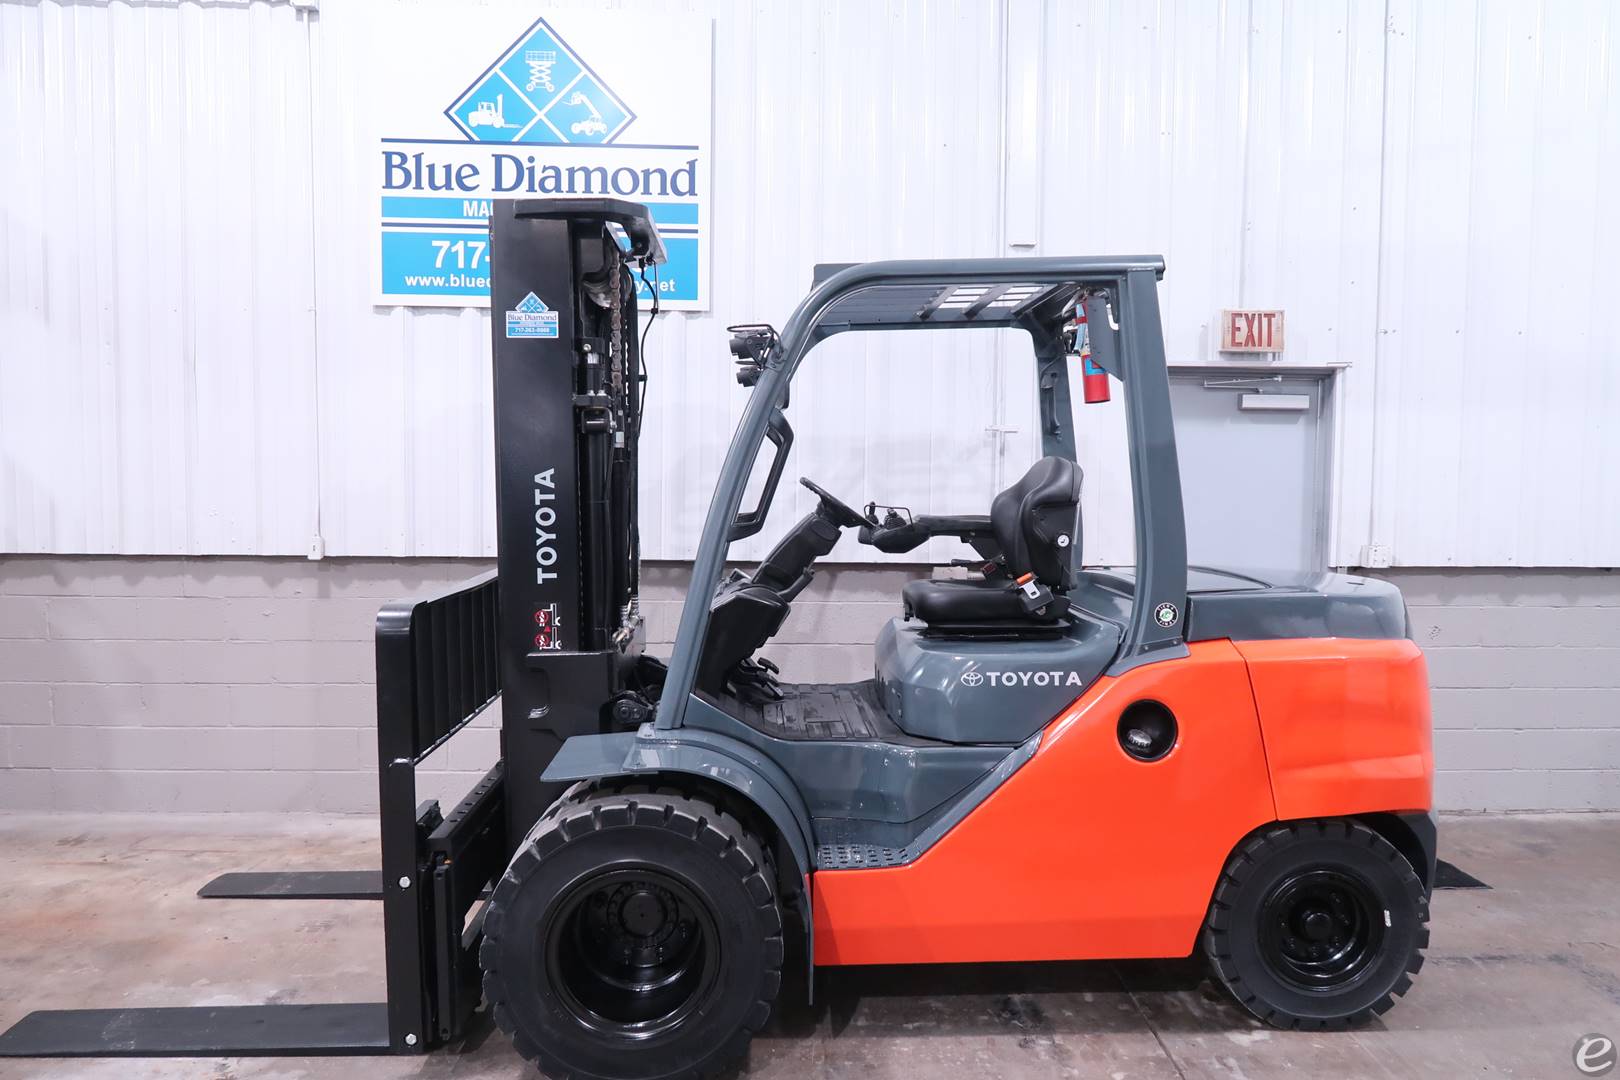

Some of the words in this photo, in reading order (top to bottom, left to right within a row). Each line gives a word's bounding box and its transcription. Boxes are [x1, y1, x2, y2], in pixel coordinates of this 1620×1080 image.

[382, 151, 480, 191] Blue
[491, 153, 698, 197] Diamond
[1231, 313, 1276, 347] EXIT
[534, 467, 558, 585] TOYOTA
[986, 671, 1082, 687] TOYOTA
